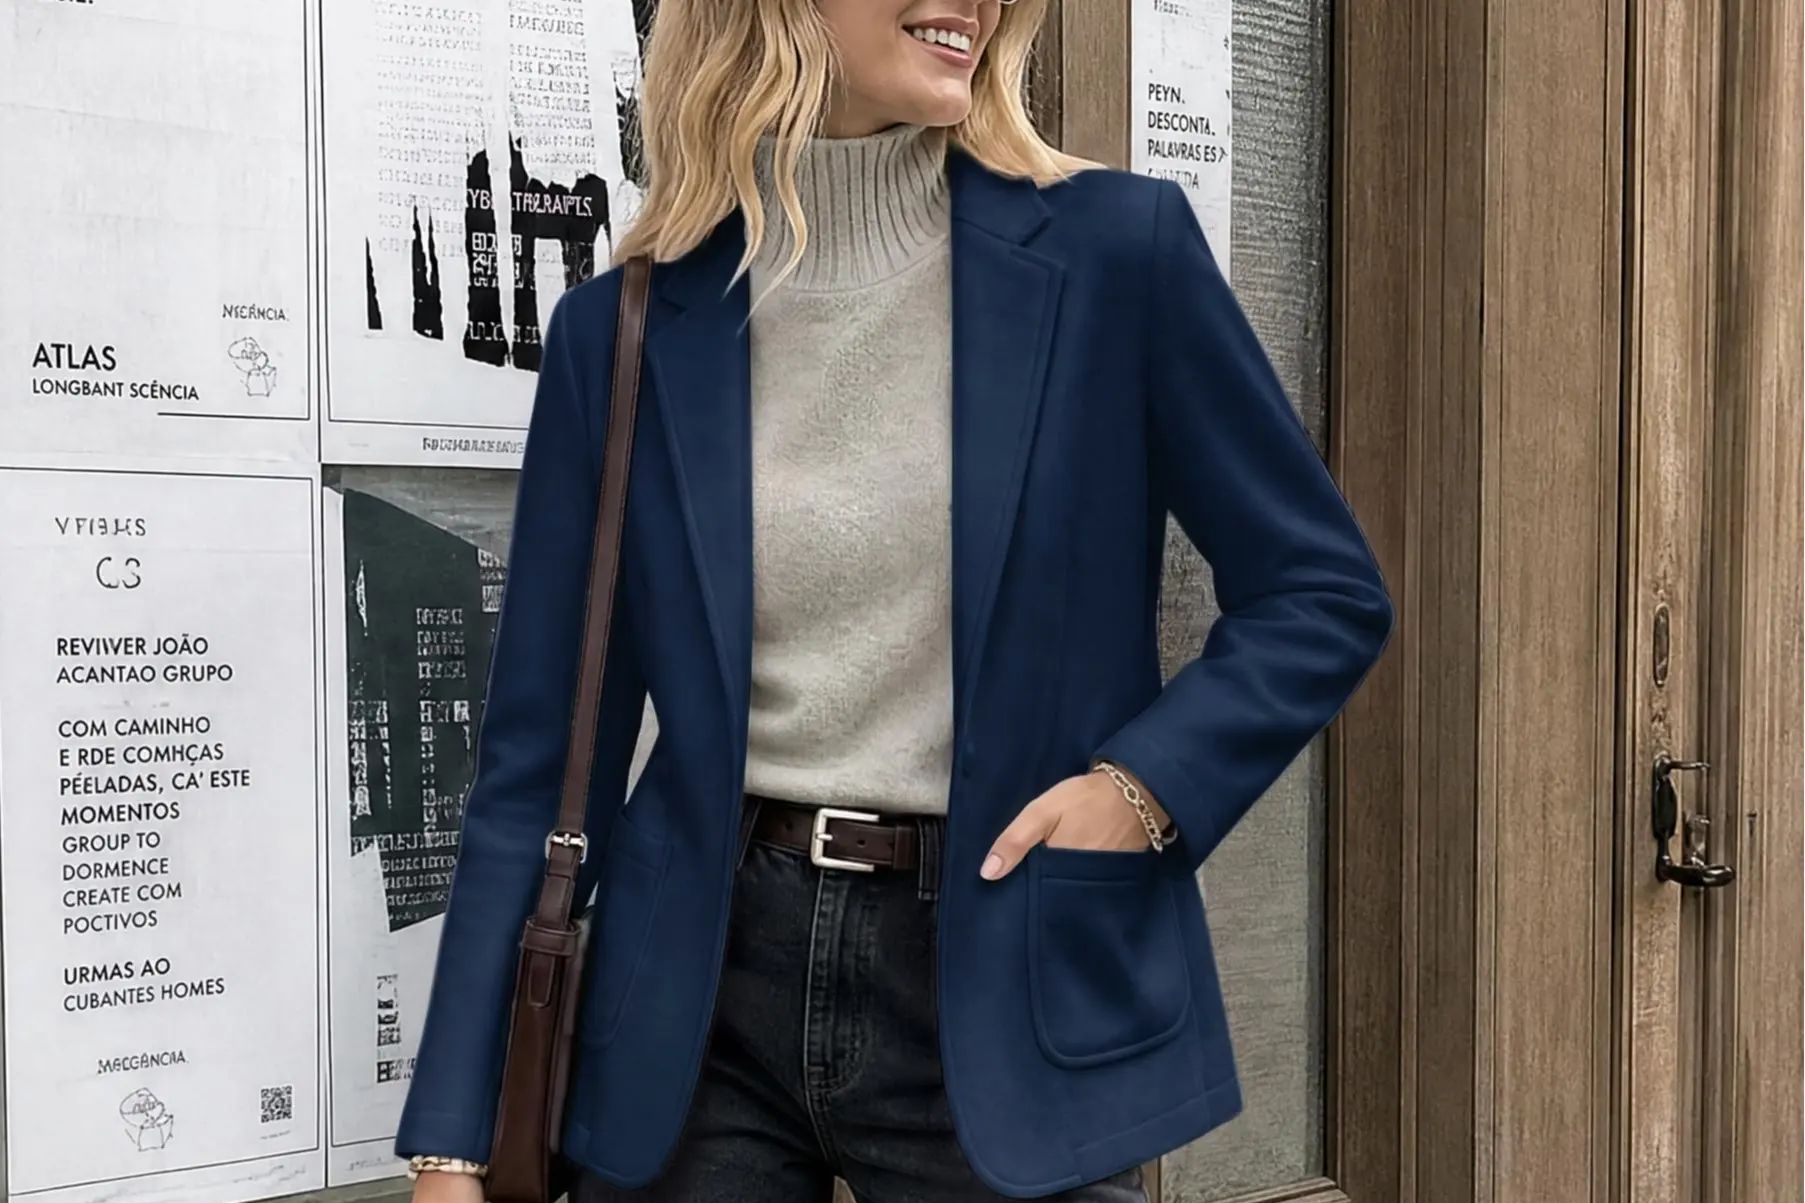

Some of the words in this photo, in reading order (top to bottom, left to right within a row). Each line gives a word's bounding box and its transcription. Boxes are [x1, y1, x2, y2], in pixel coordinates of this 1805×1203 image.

[1148, 139, 1201, 161] PALAVRAS
[32, 342, 116, 371] ATLAS
[33, 378, 124, 397] LONGBANT
[153, 633, 208, 655] JOÃO
[57, 665, 156, 683] ACANTAO
[163, 664, 233, 682] GRUPO
[58, 720, 107, 738] COM
[115, 716, 210, 736] CAMINHO
[60, 749, 69, 766] E
[78, 747, 115, 766] RDE
[210, 770, 250, 788] ESTE
[61, 802, 180, 825] MOMENTOS
[63, 833, 130, 853] GROUP
[136, 832, 160, 848] TO
[63, 858, 168, 881] DORMENCE
[63, 886, 130, 907] CREATE
[137, 882, 181, 901] COM
[64, 910, 157, 934] POCTIVOS
[64, 961, 134, 985] URMAS
[141, 958, 170, 977] AO
[64, 986, 155, 1011] CUBANTES
[161, 978, 224, 1000] HOMES
